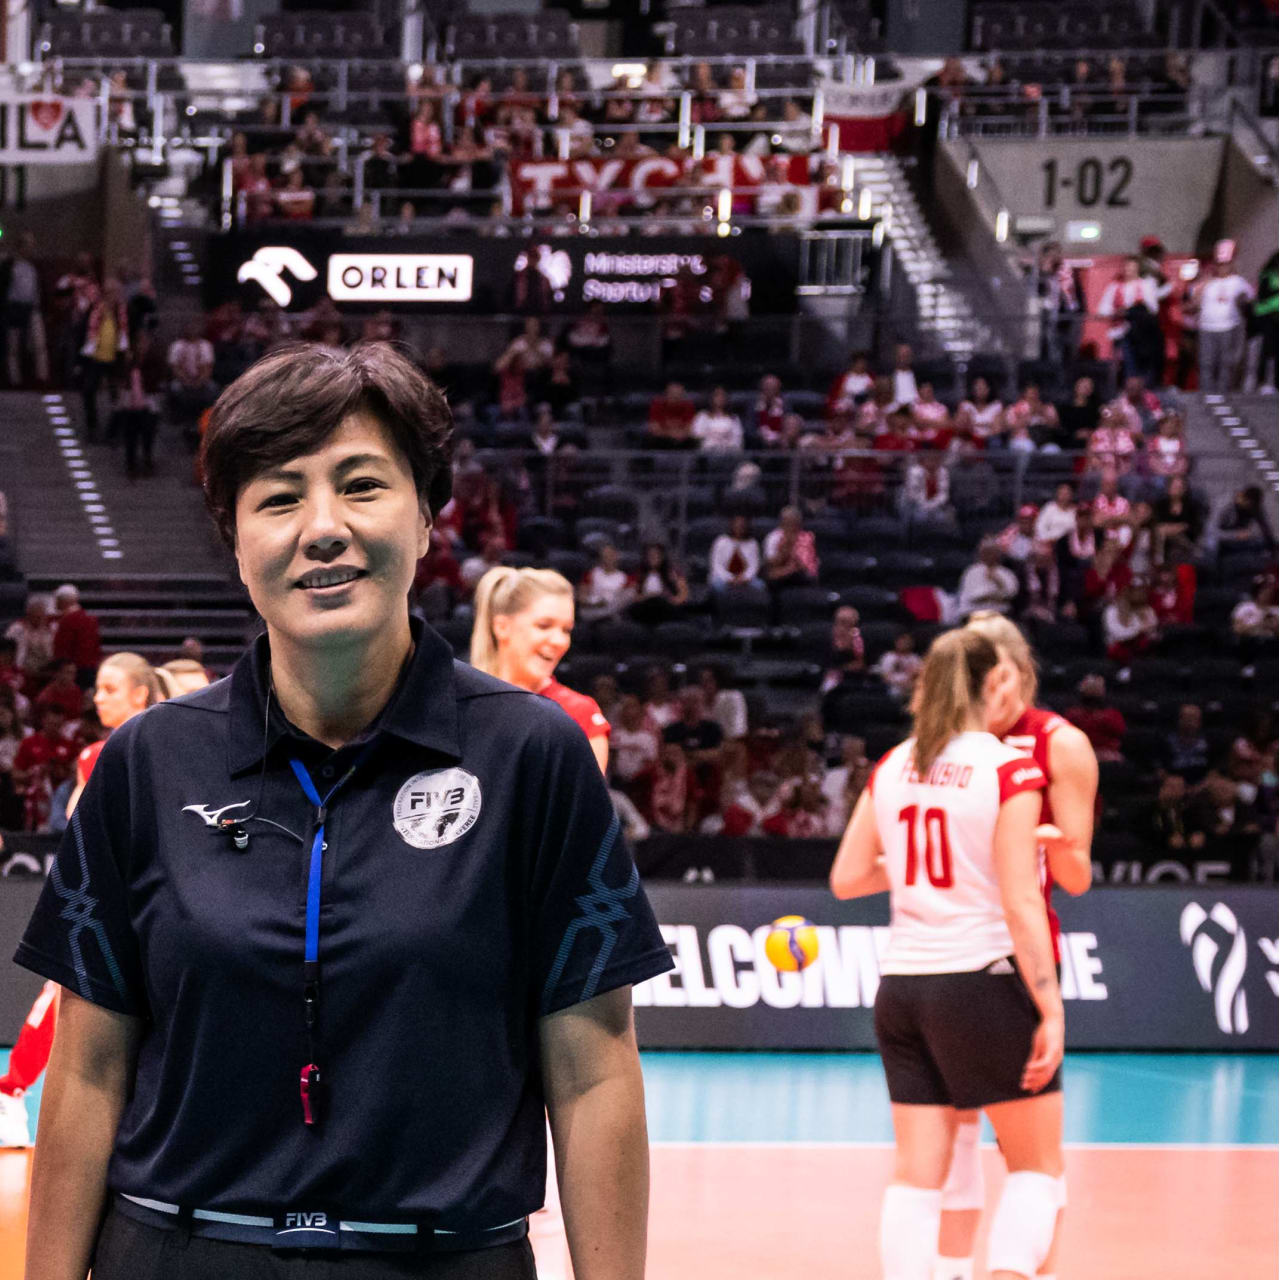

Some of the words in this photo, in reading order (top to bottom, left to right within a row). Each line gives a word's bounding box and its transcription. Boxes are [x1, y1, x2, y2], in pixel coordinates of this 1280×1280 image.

[1042, 157, 1133, 208] 1-02
[341, 265, 459, 290] ORLEN
[899, 804, 955, 889] 10
[631, 924, 889, 1008] ELCOM
[286, 1212, 327, 1227] FIVB
